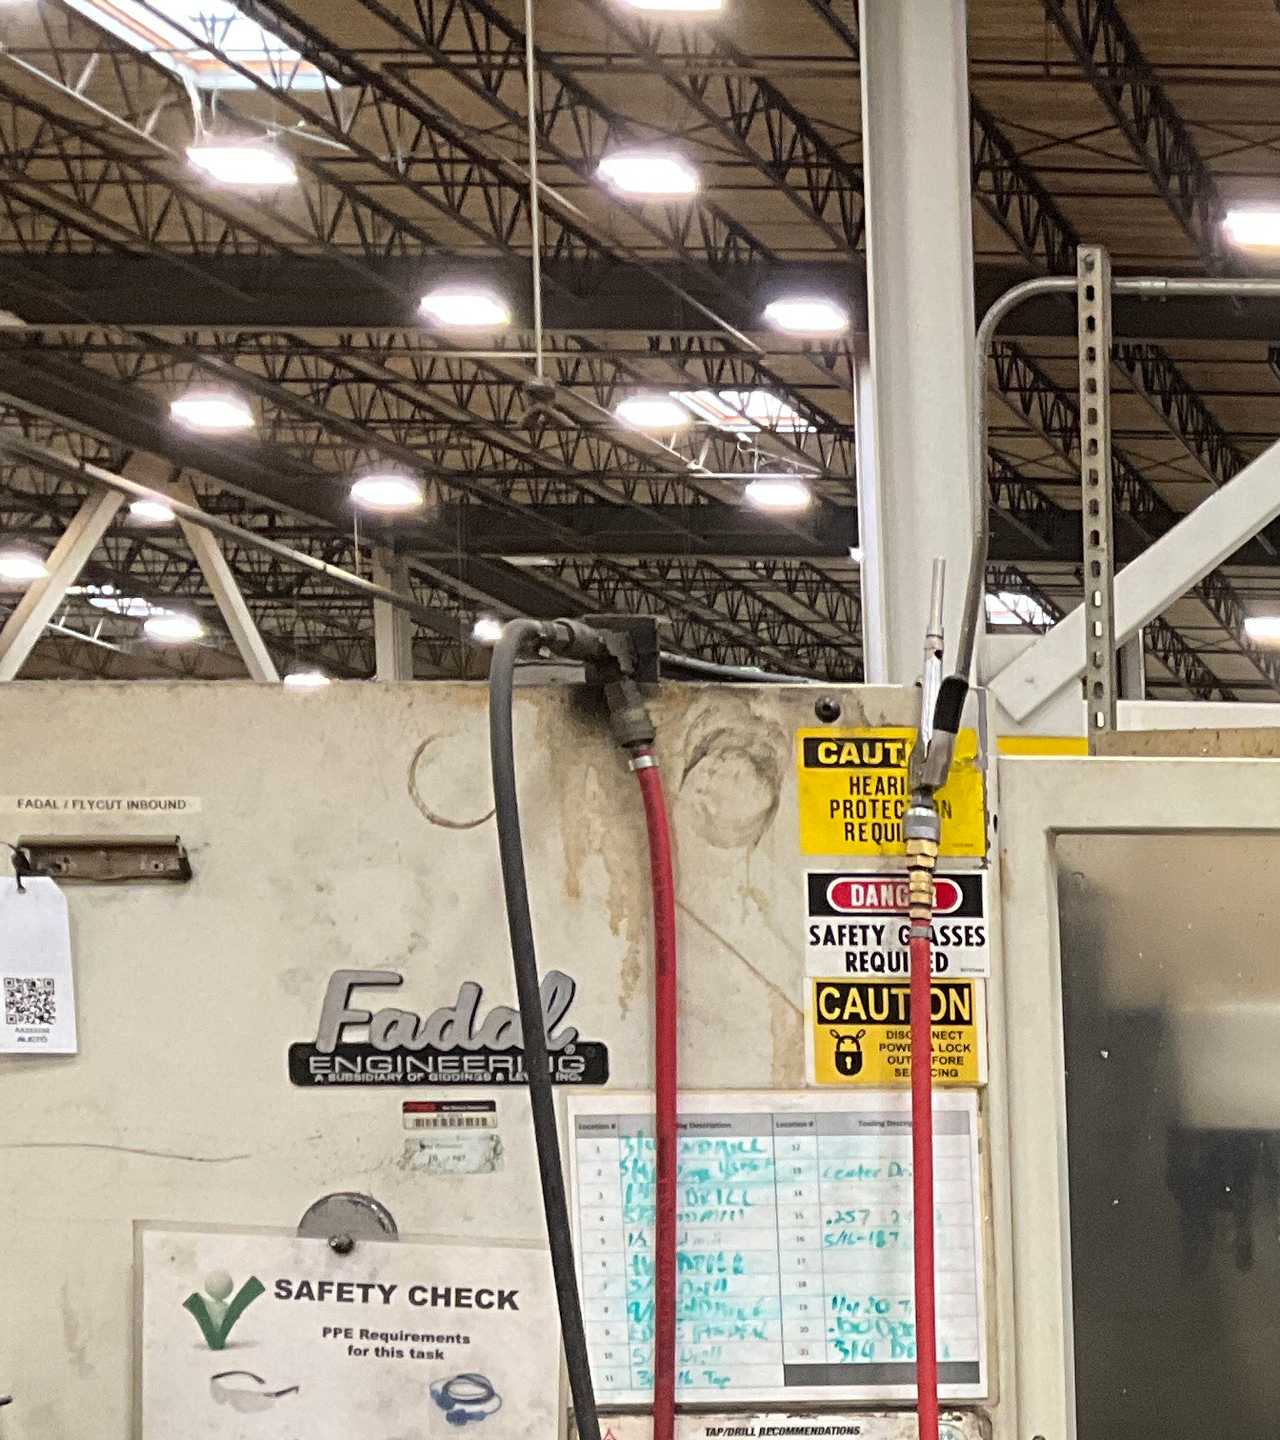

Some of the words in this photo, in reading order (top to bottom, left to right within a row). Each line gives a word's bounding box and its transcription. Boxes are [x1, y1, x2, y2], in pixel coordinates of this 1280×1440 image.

[849, 775, 905, 796] HEARI
[17, 799, 60, 810] FADAL
[72, 799, 122, 810] FLYCUT
[127, 800, 187, 810] INBOUND
[830, 799, 953, 820] PROTECN
[844, 822, 901, 846] REQUI
[809, 924, 885, 947] SAFETY
[898, 924, 986, 947] GASSES
[845, 951, 949, 973] REQUID
[315, 969, 579, 1053] Fadal
[818, 986, 970, 1021] CAUTON
[886, 1030, 964, 1040] DISCNECT
[879, 1043, 912, 1053] POWE
[938, 1043, 972, 1053] LOCK
[309, 1055, 586, 1075] ENGINEERIG
[887, 1056, 911, 1066] OUT
[932, 1056, 964, 1066] FORE
[314, 1074, 325, 1083] A
[328, 1072, 403, 1083] SUBSIDIARY
[408, 1072, 425, 1082] OF
[428, 1072, 491, 1082] GIDDINGS
[894, 1068, 960, 1078] SECING
[578, 1122, 609, 1130] Location
[775, 1120, 807, 1128] Location
[858, 1120, 885, 1128] Tooling
[886, 1120, 913, 1128] Descrip
[273, 1278, 398, 1305] SAFETY
[408, 1285, 520, 1311] CHECK
[322, 1326, 354, 1340] PPE
[359, 1328, 471, 1345] Requirements
[347, 1345, 369, 1357] for
[374, 1346, 404, 1359] this
[409, 1348, 445, 1360] task
[705, 1427, 757, 1438] TAP/DRILL
[758, 1425, 861, 1438] RECOMMENDATIONS
